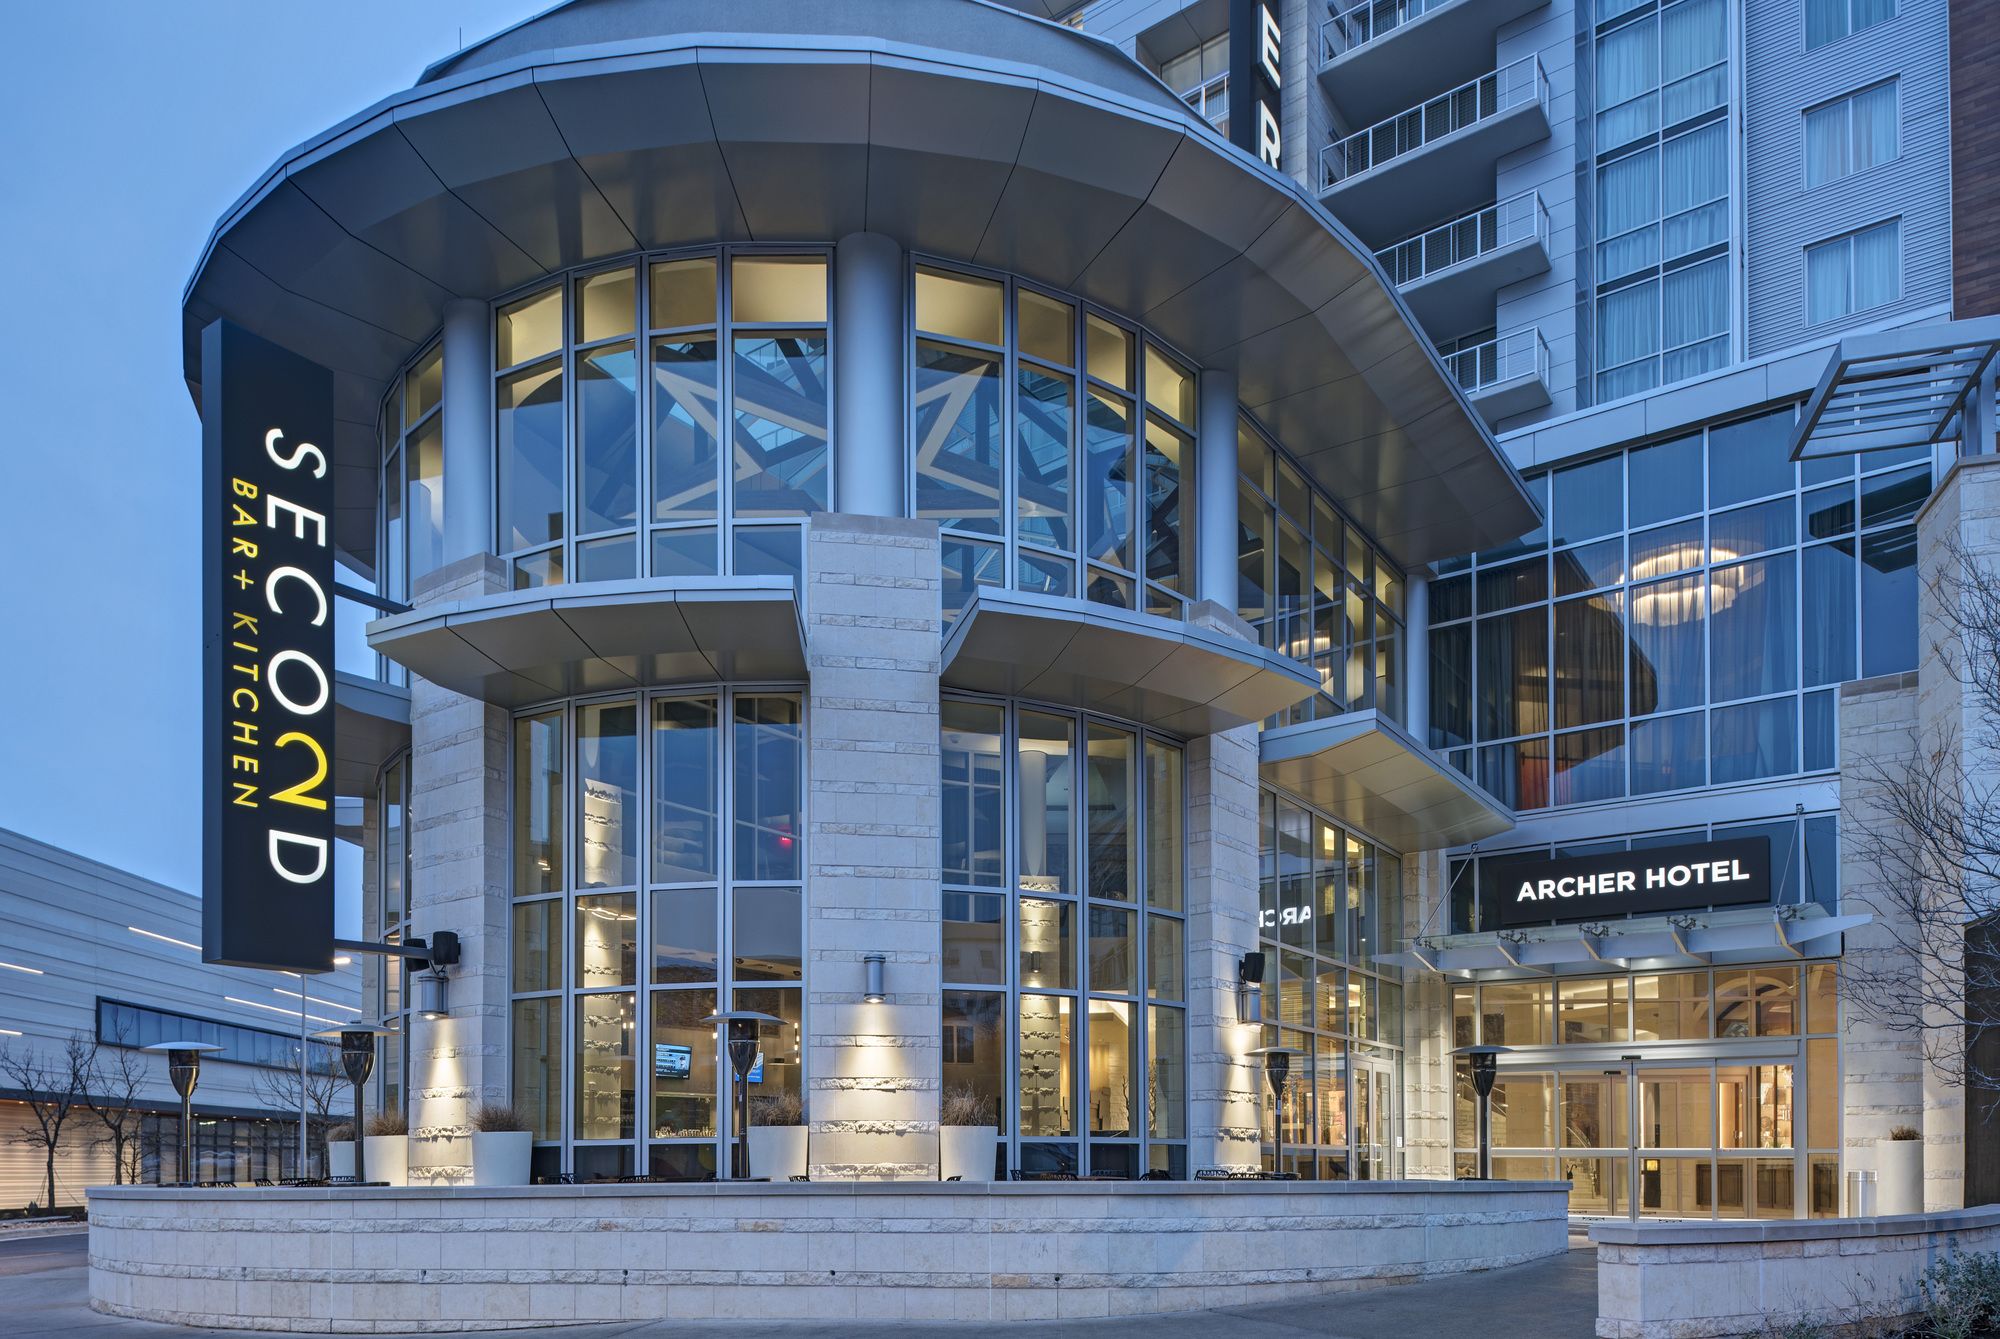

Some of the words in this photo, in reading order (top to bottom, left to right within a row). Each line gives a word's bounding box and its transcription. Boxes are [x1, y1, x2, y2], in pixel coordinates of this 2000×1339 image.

[232, 611, 259, 808] KITCHEN
[1516, 871, 1636, 902] ARCHER
[1646, 859, 1750, 889] HOTEL
